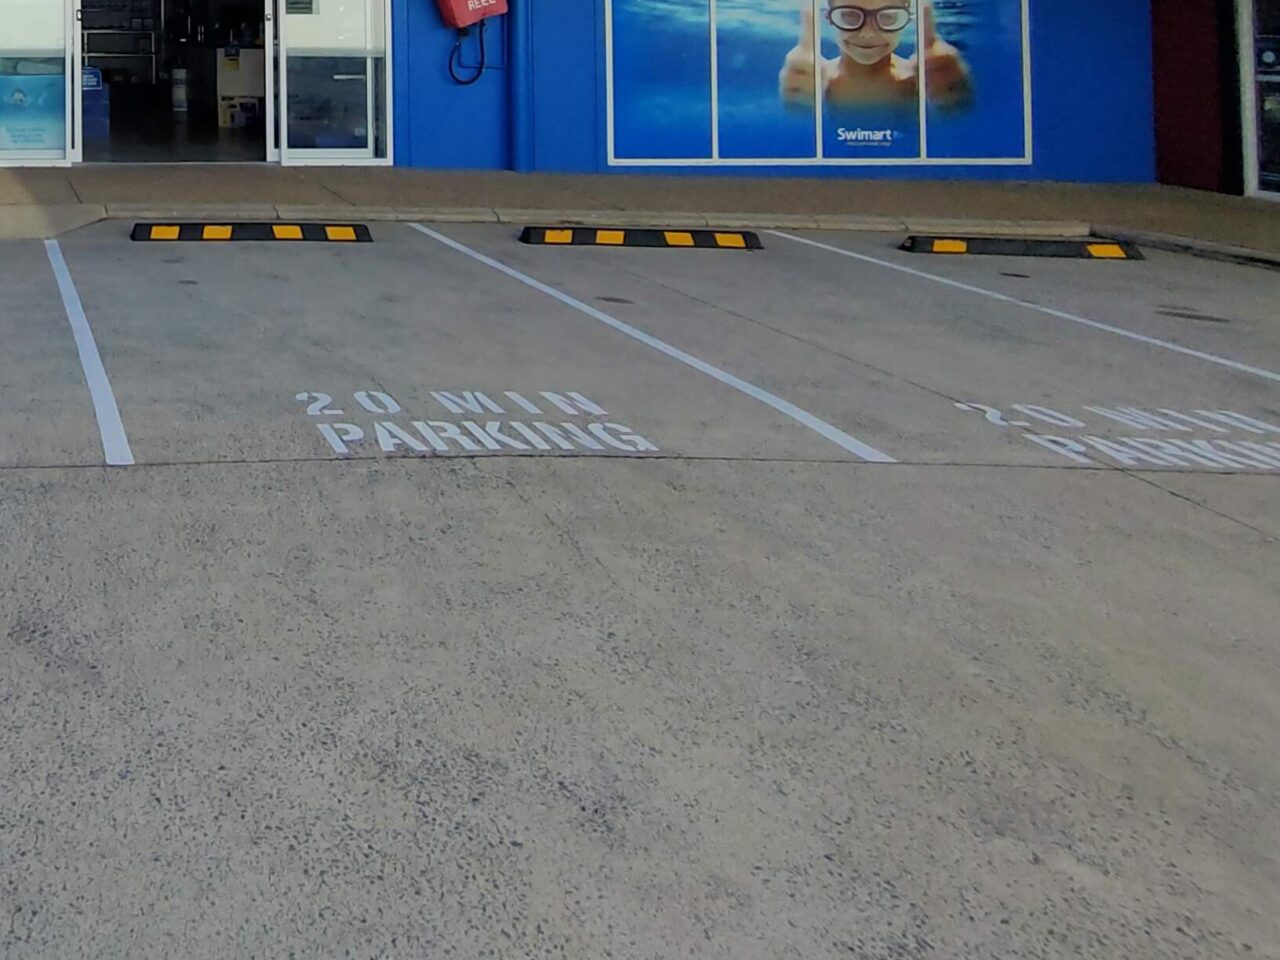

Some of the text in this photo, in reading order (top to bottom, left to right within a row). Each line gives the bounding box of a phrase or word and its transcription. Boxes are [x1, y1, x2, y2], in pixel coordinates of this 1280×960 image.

[836, 127, 892, 141] Swimart
[429, 390, 609, 416] MIN
[316, 420, 660, 454] PARKING
